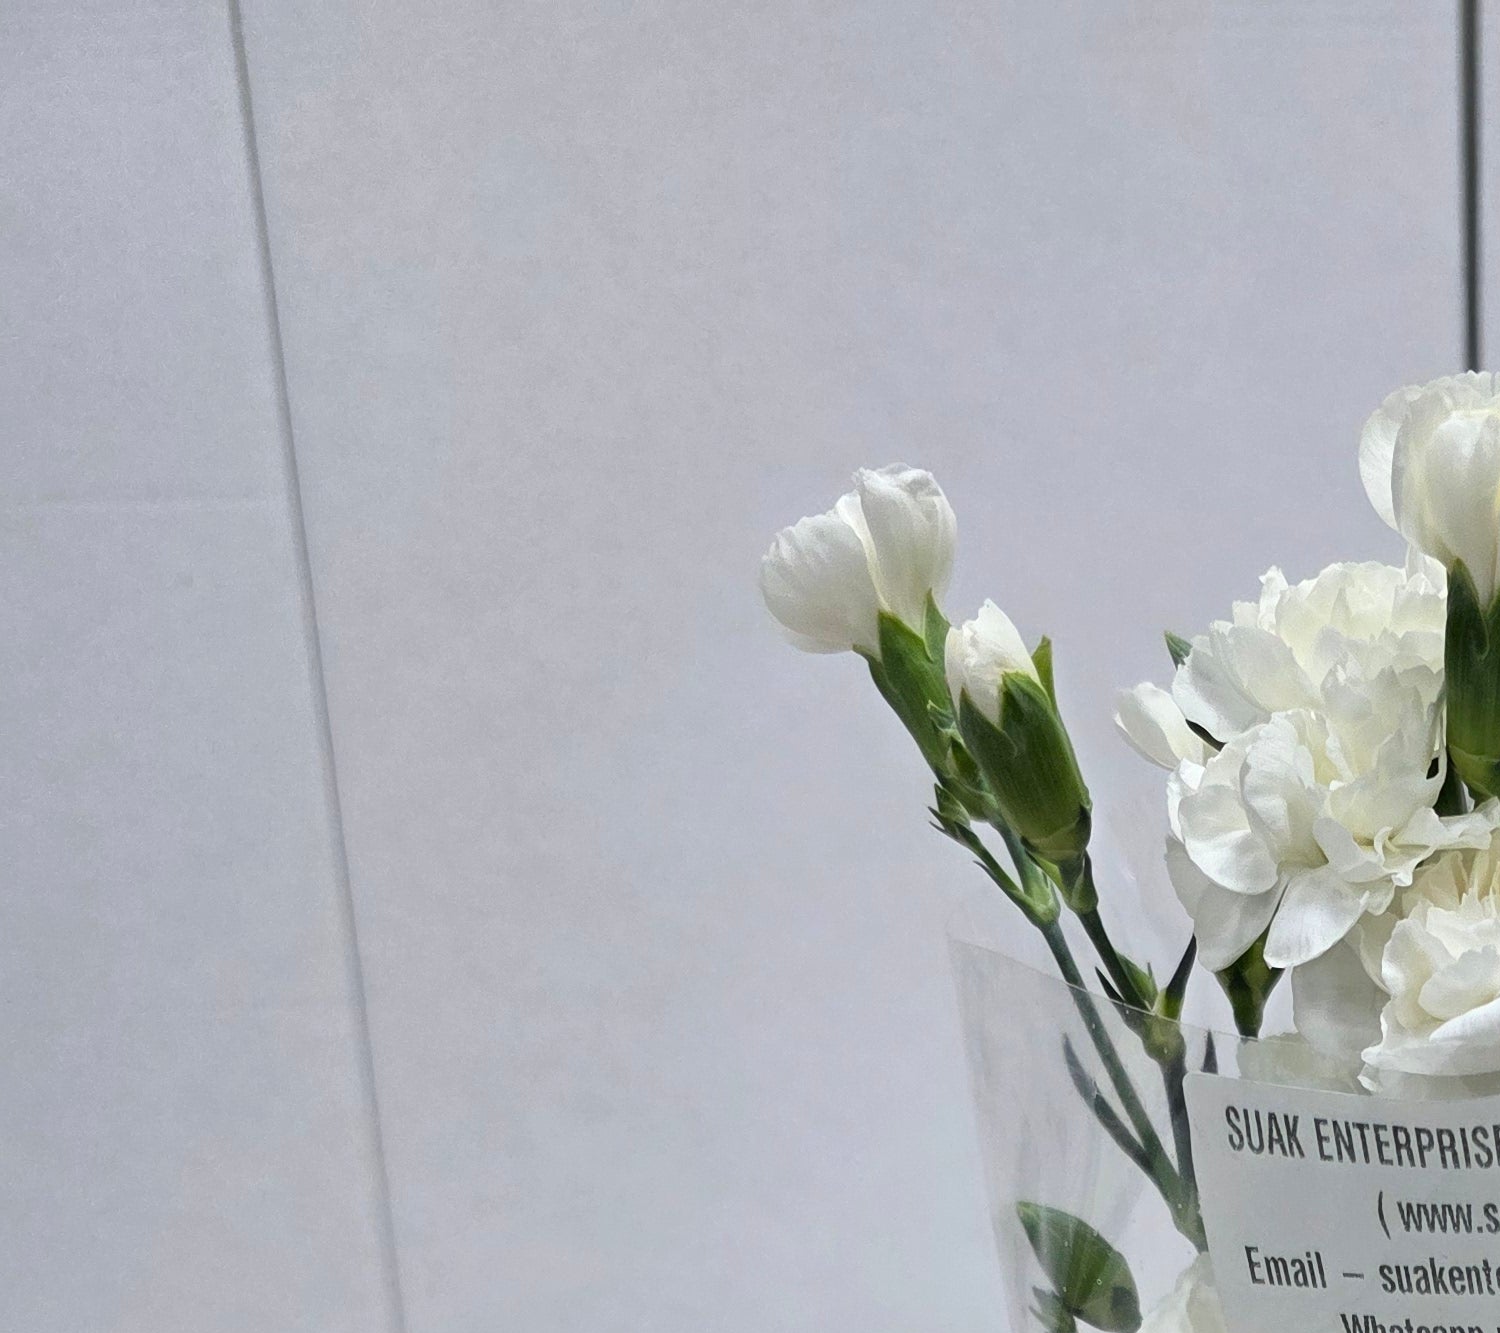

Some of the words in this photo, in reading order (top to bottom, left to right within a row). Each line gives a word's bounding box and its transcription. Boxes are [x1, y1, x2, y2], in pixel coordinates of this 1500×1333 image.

[1225, 1106, 1305, 1158] SUAK
[1378, 1191, 1390, 1240] (
[1245, 1245, 1327, 1288] Email
